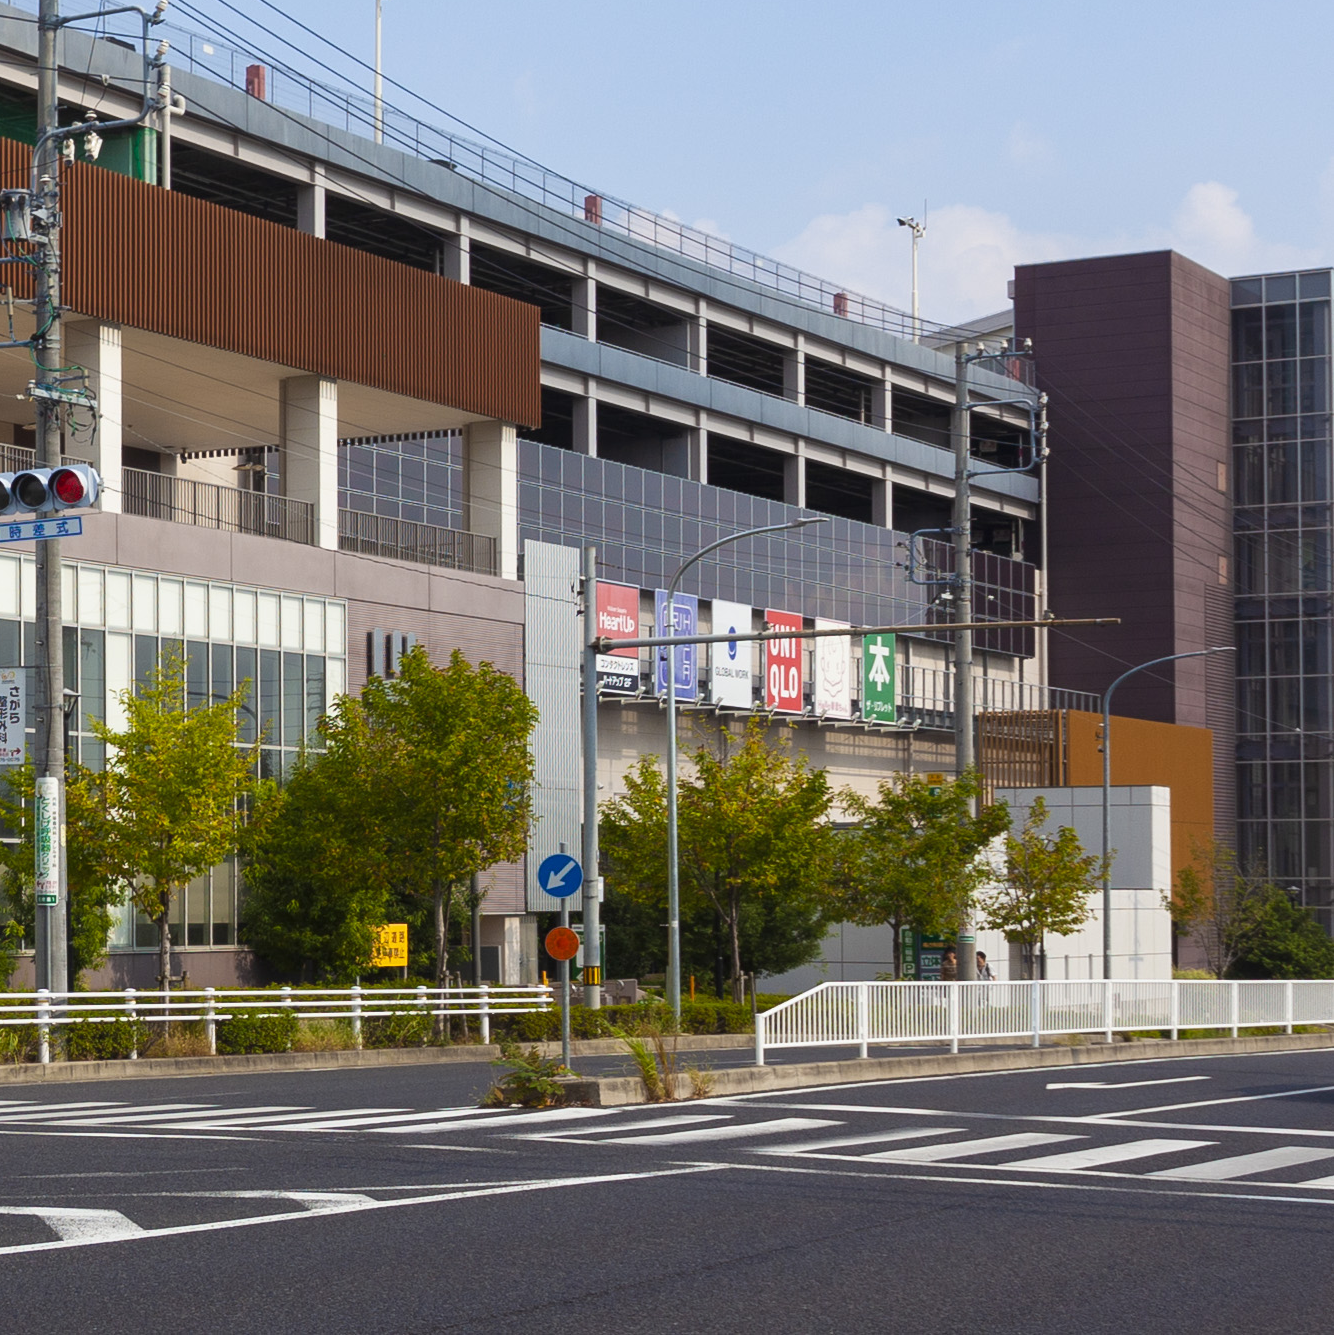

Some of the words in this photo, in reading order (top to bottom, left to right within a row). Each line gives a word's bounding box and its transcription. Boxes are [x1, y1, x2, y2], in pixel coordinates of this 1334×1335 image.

[9, 521, 70, 538] 時差式
[769, 622, 797, 659] UNI
[715, 666, 734, 678] GLOBAL
[735, 669, 749, 680] WORK
[769, 663, 799, 704] QLO
[9, 686, 20, 724] さがら
